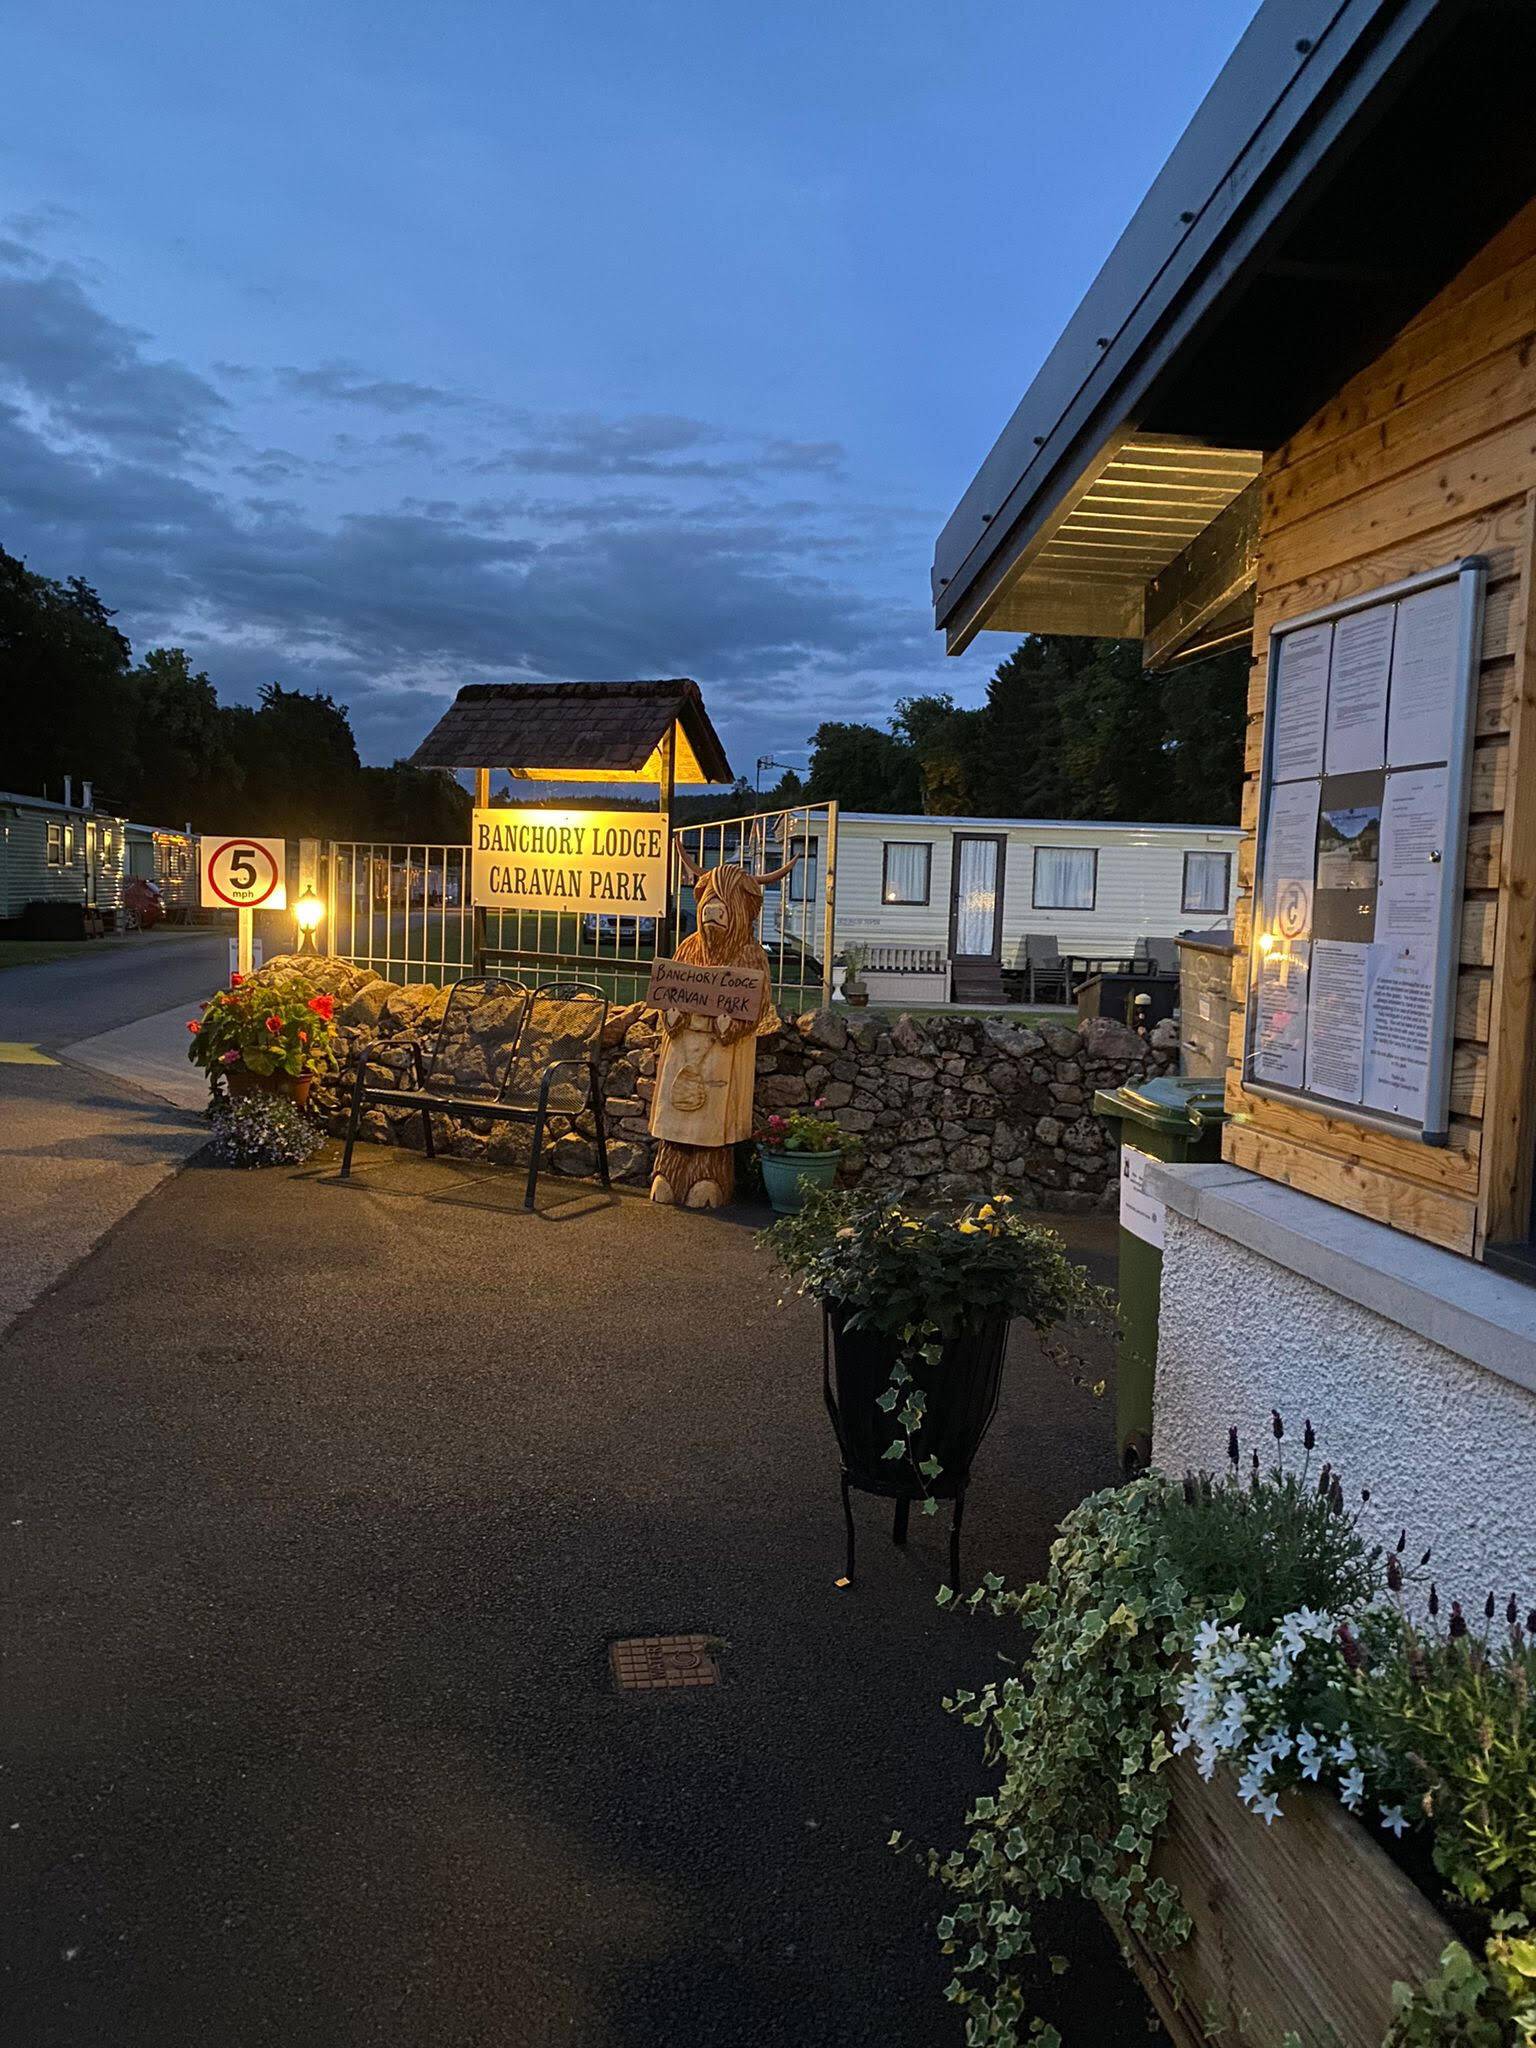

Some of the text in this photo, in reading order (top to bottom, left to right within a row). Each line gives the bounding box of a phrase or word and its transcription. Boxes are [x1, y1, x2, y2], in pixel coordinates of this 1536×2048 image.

[478, 823, 661, 858] BANCHORY LODGE
[229, 850, 257, 889] 5
[489, 865, 647, 901] CARAVAN PARK
[232, 891, 254, 899] mph
[656, 964, 719, 985] BANCHORY
[653, 987, 750, 1013] CARAVAN PARK
